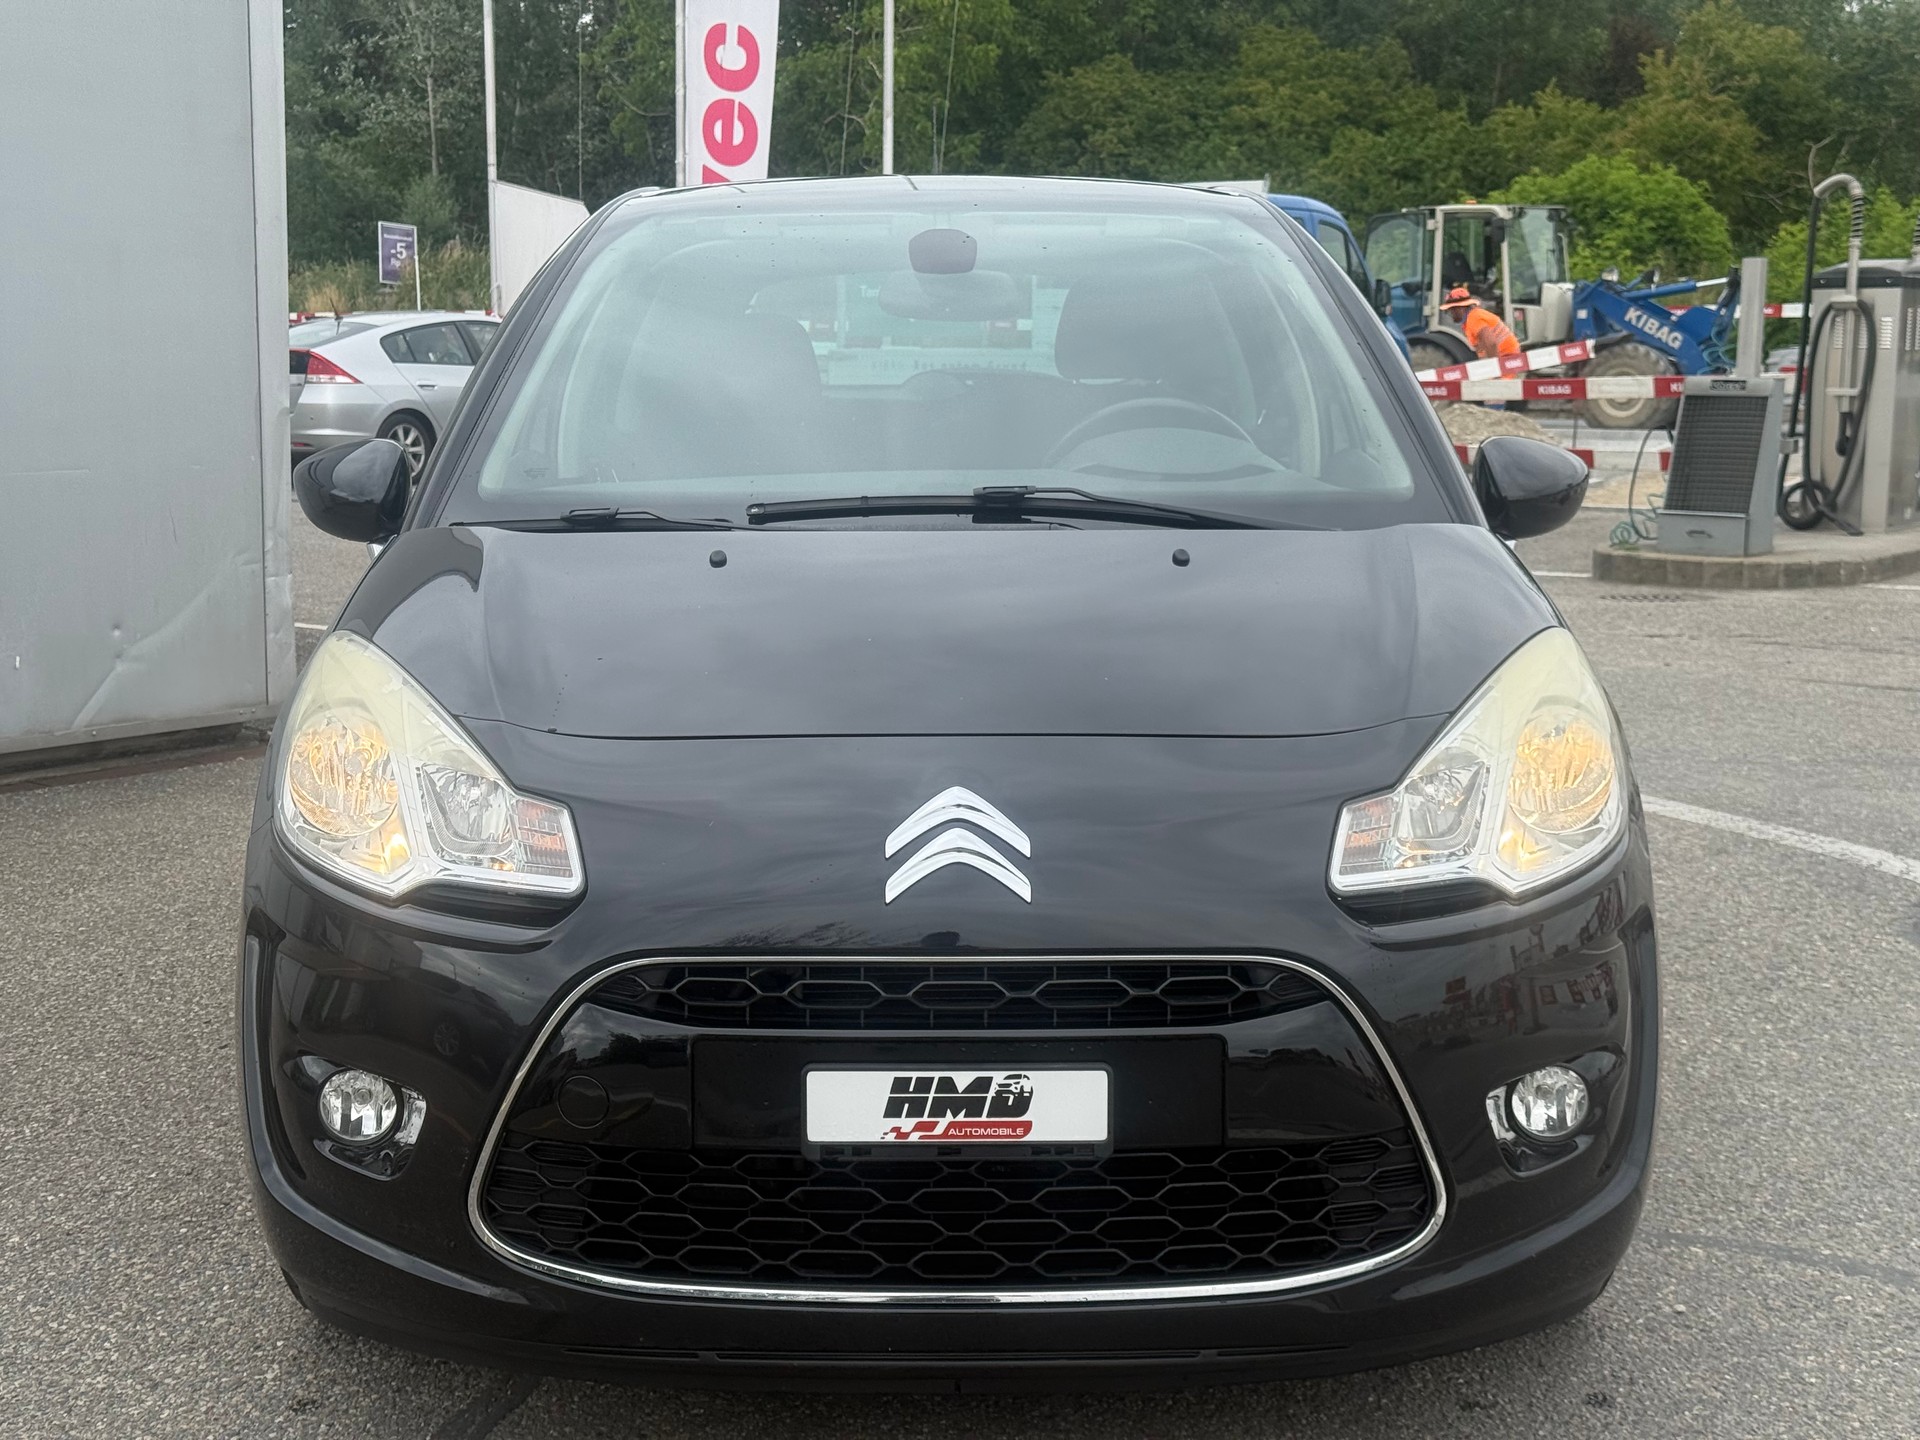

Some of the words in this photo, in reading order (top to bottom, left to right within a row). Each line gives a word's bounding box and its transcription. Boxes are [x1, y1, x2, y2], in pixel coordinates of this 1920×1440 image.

[390, 242, 407, 259] -5
[1624, 306, 1684, 350] KIBAG
[1537, 384, 1572, 395] KIBAG
[948, 1127, 1024, 1136] AUTOMOBILE
